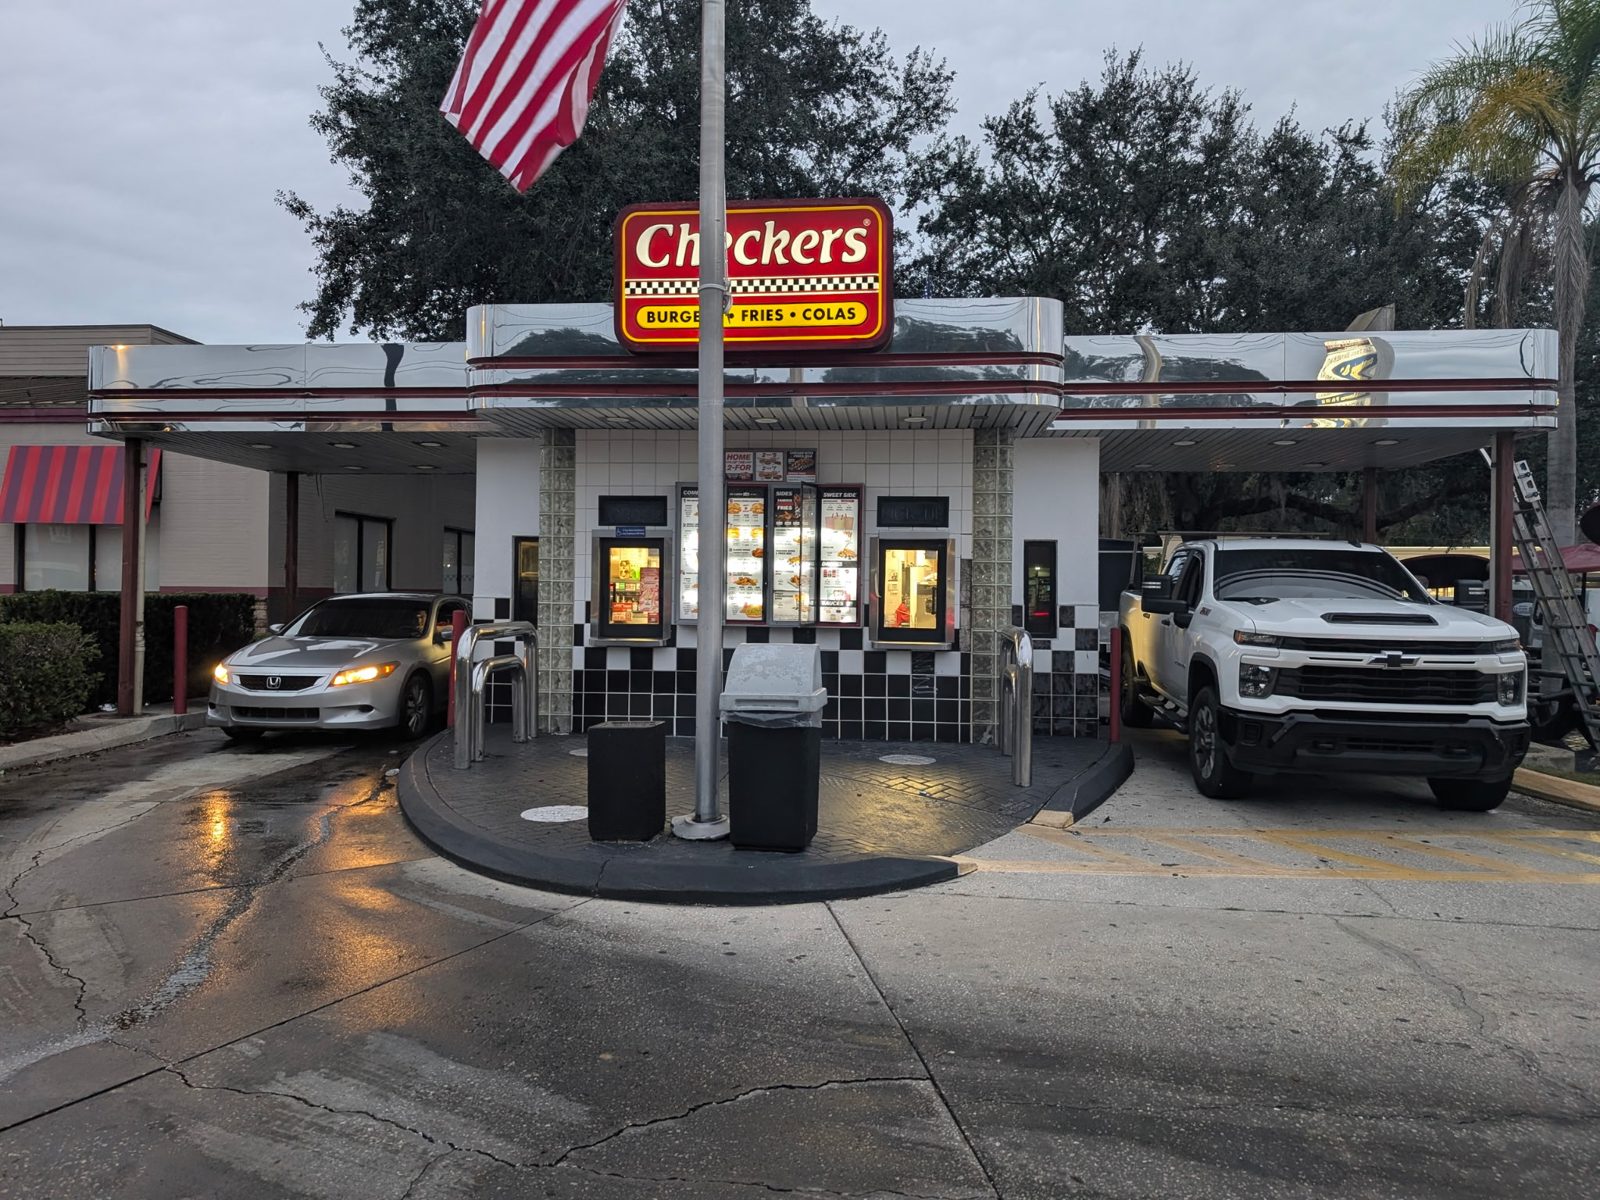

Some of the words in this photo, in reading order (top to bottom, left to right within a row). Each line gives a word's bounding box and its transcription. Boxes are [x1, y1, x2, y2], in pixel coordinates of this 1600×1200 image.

[636, 220, 868, 268] Chckers
[646, 311, 700, 323] BURGE
[741, 309, 784, 322] FRIES
[802, 308, 856, 321] COLAS
